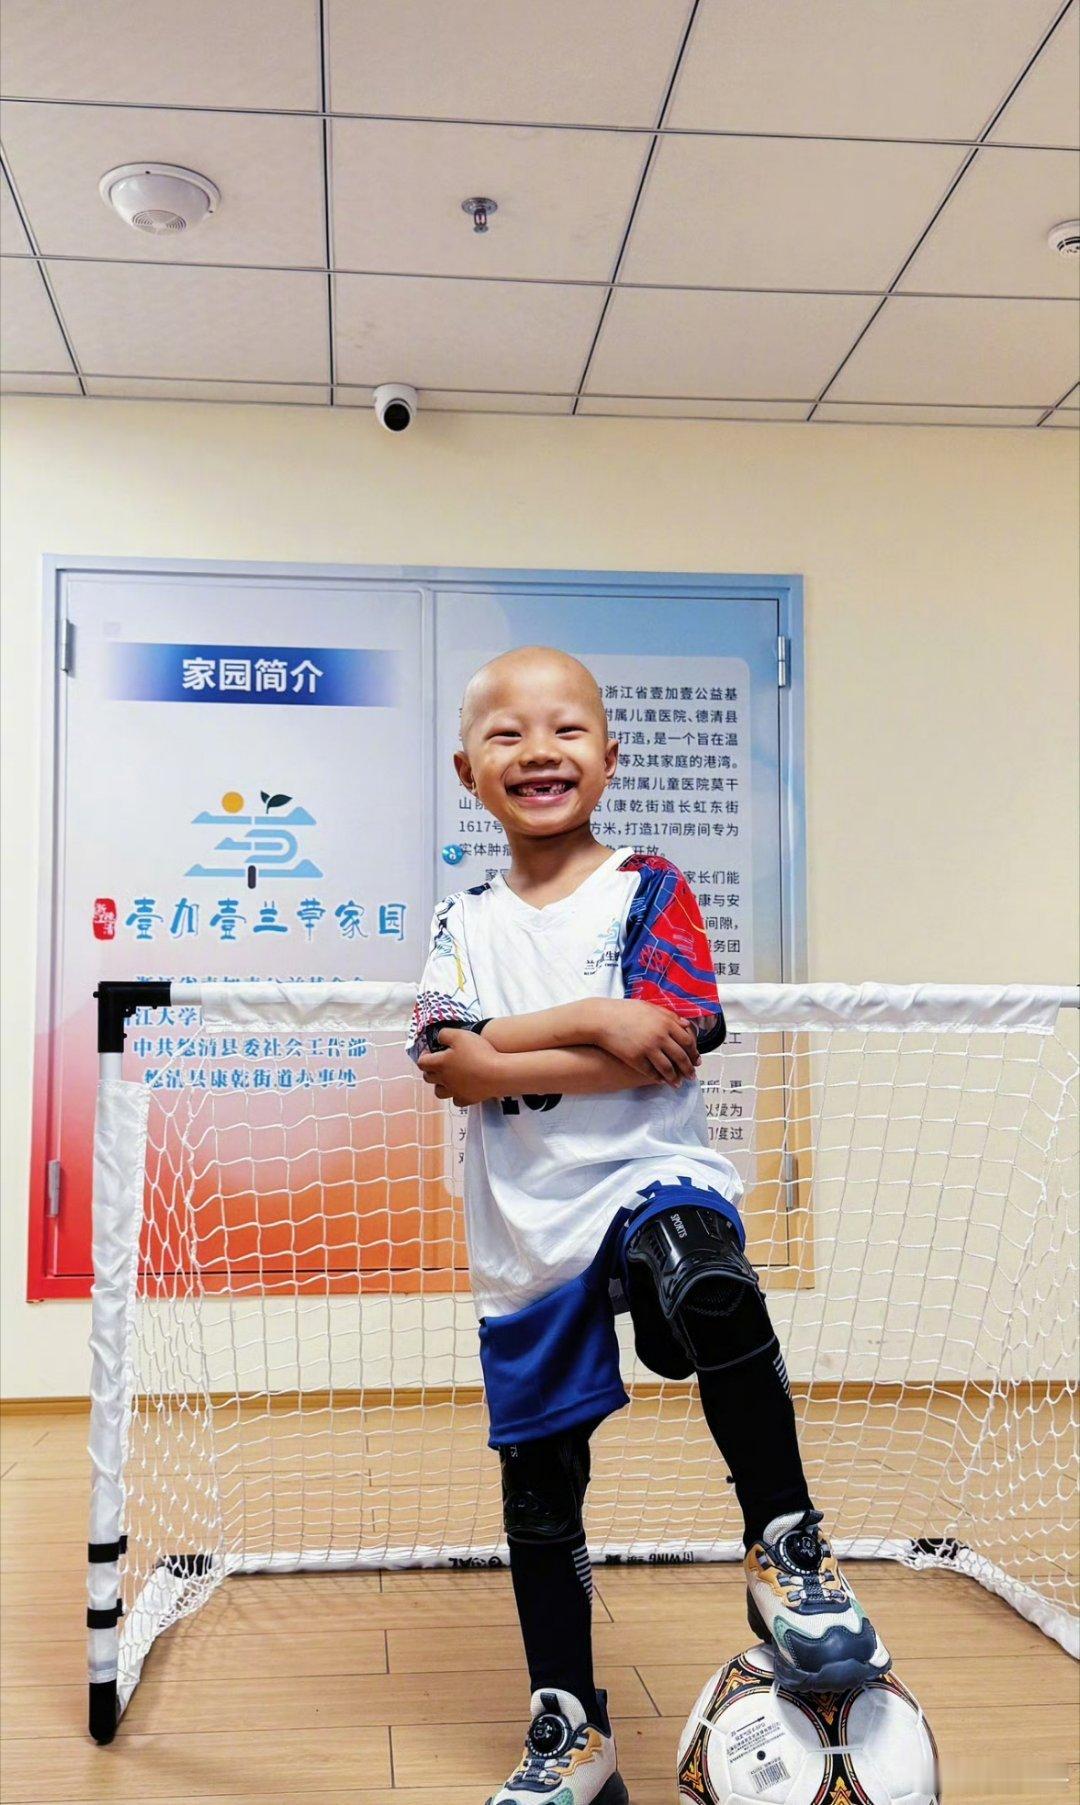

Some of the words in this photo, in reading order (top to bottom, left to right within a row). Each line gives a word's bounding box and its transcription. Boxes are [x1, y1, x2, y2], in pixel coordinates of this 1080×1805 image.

[182, 657, 323, 693] 家园简介
[598, 685, 738, 701] 浙江省壹加壹公益基
[618, 753, 738, 769] 等及其家庭的港湾。
[459, 821, 503, 834] 1617号
[708, 940, 740, 953] 务团
[670, 1213, 688, 1239] SPORTS
